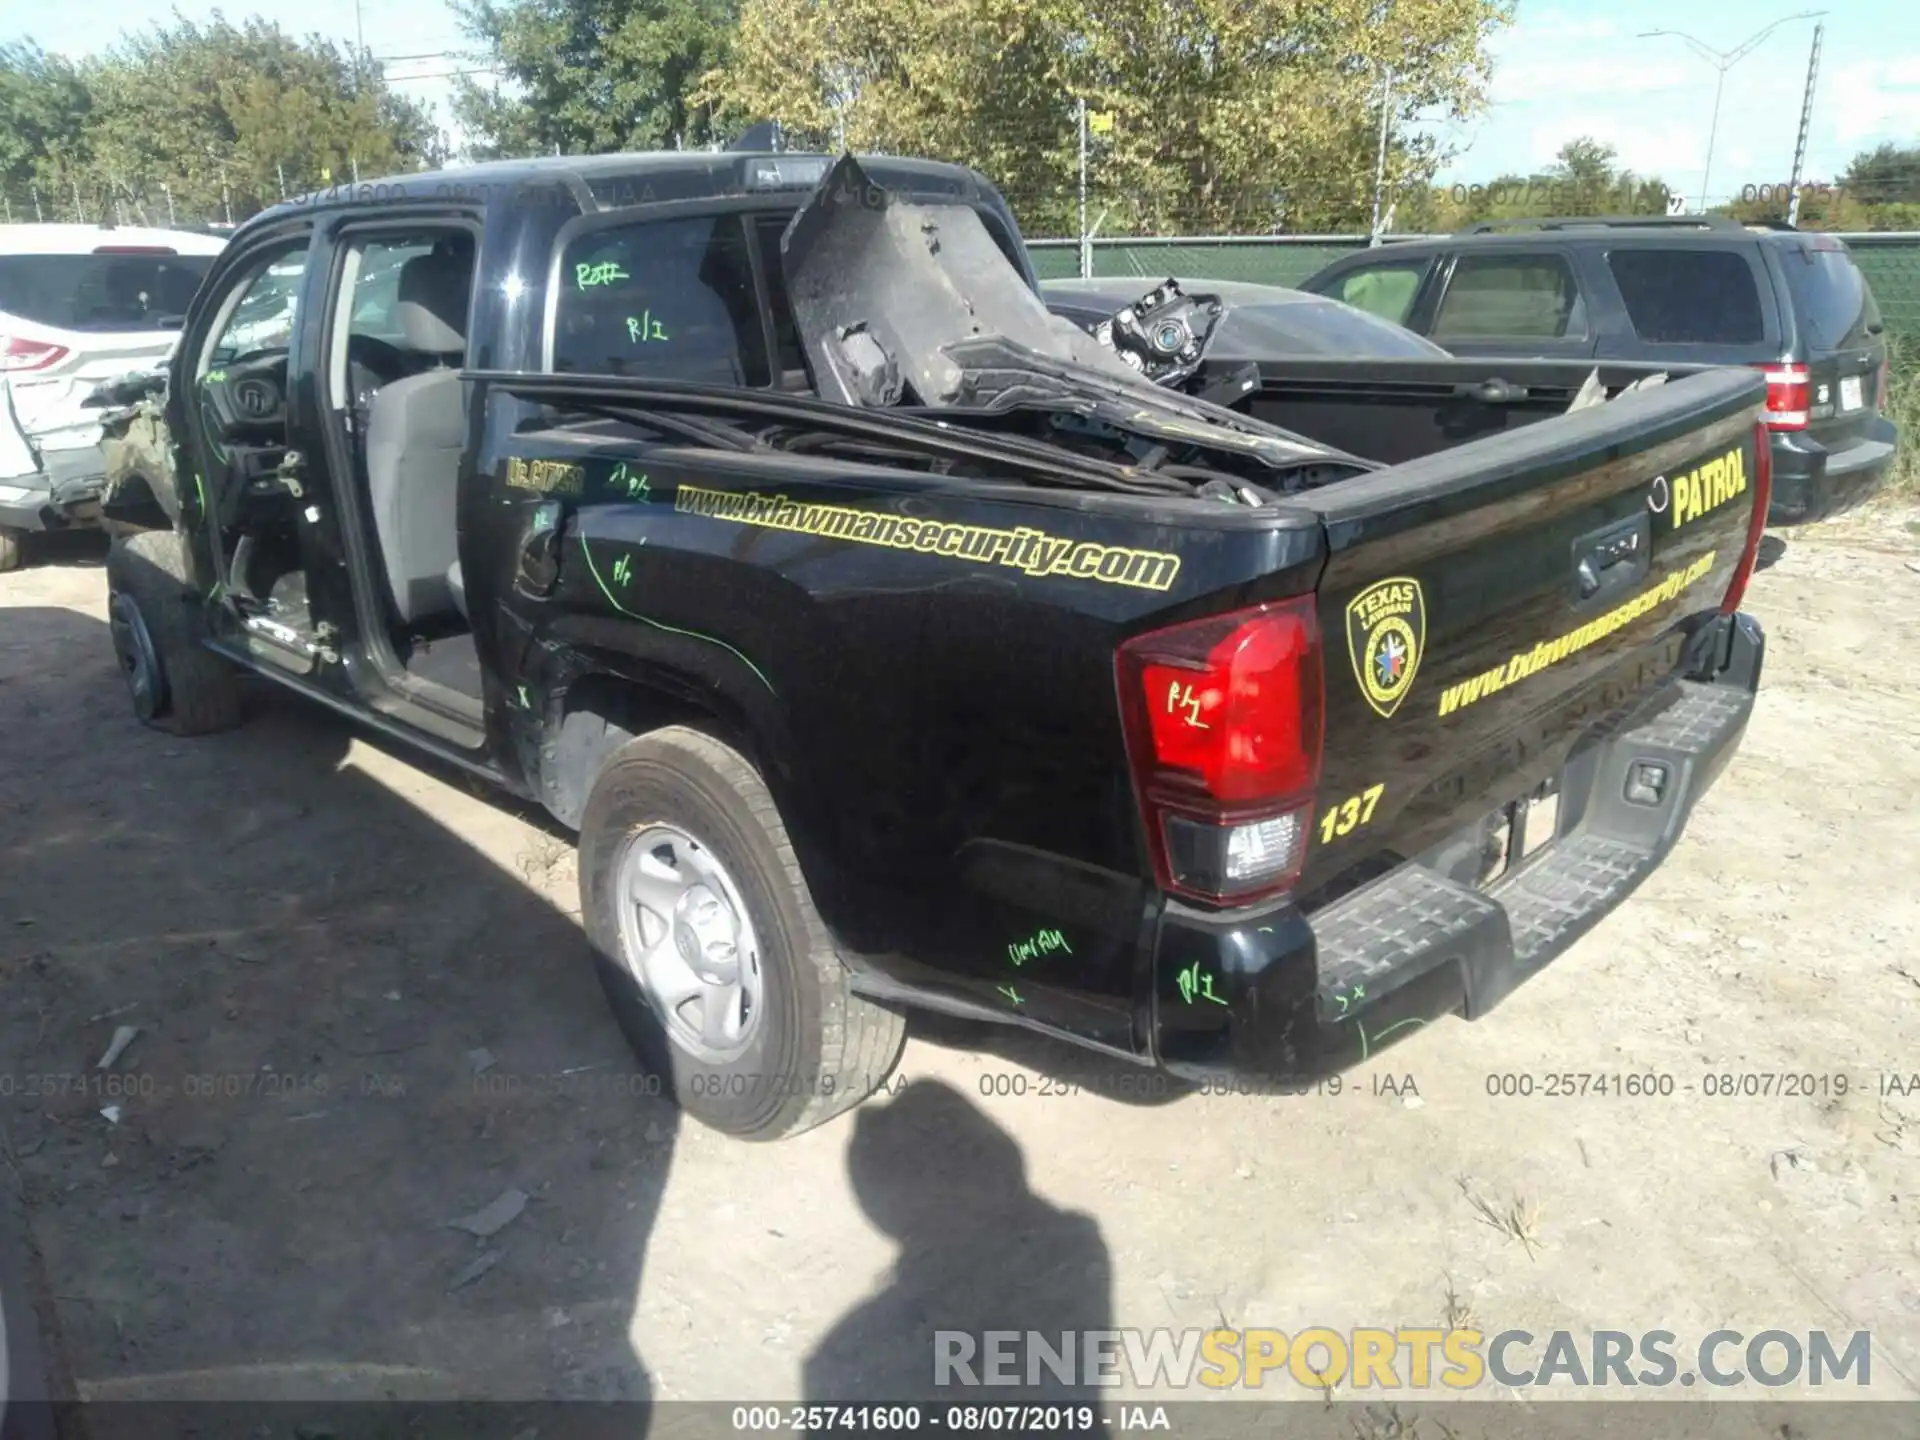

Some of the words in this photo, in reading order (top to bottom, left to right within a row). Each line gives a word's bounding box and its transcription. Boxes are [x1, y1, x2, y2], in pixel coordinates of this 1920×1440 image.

[1673, 447, 1747, 529] PATROL
[674, 484, 1182, 591] www.txlawmansecurity.com
[1353, 584, 1414, 620] TEXAS
[1361, 602, 1412, 631] LAWMAN
[1320, 782, 1385, 845] 137
